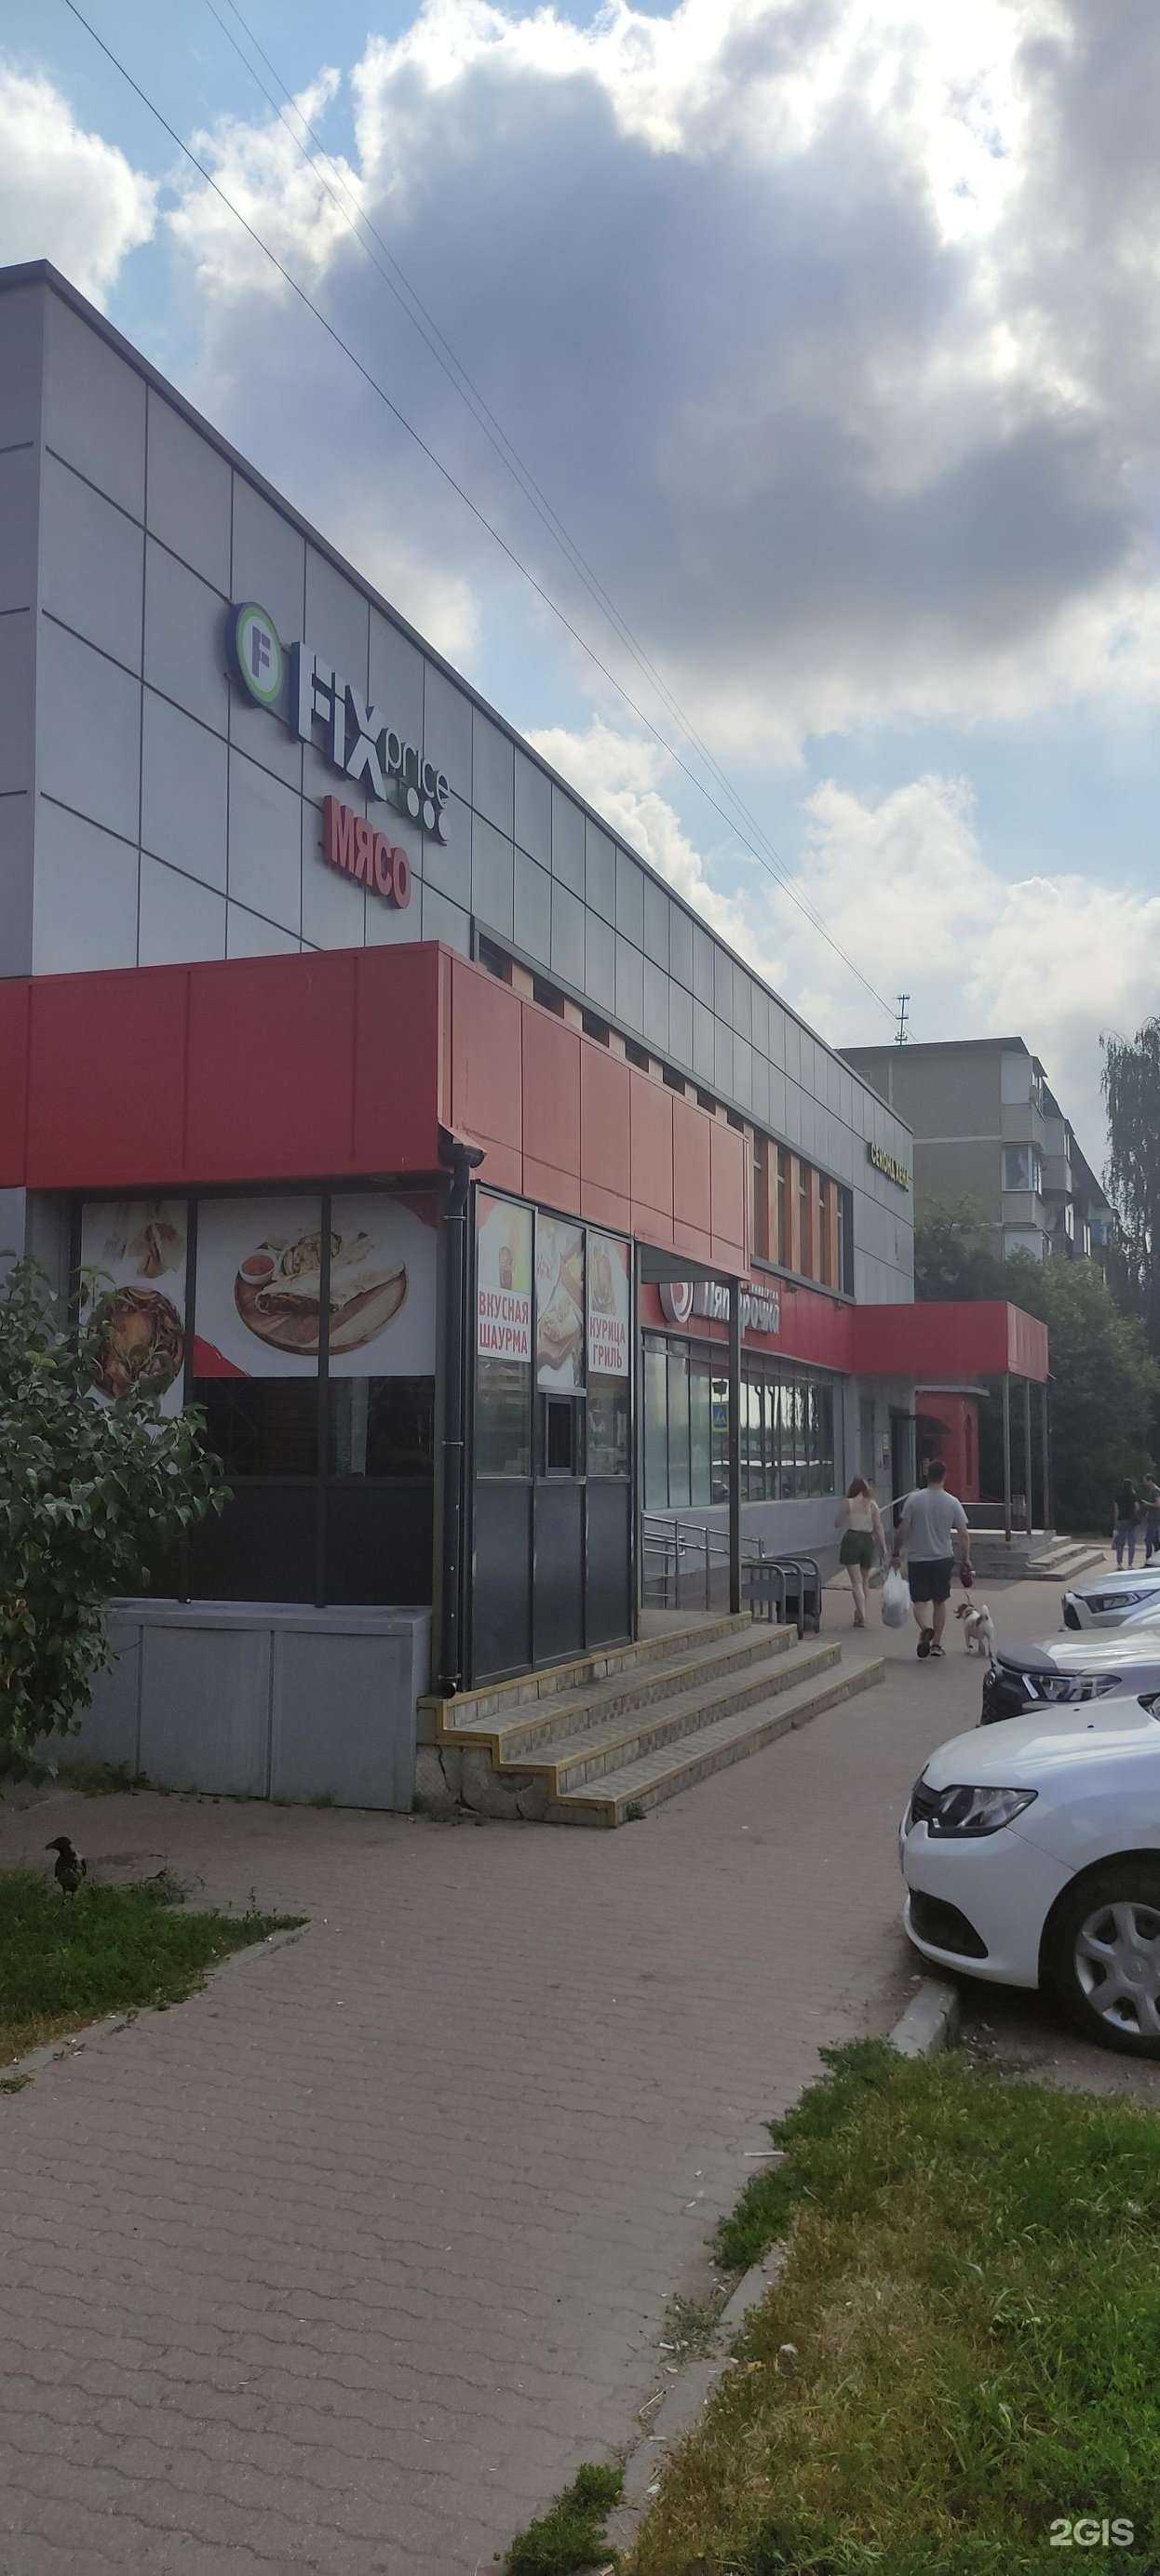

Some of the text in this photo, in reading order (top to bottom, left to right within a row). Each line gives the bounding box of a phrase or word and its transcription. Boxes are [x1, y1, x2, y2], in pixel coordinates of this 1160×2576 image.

[384, 727, 451, 809] price
[324, 795, 411, 909] МЯСО
[479, 1291, 529, 1325] ВКУСНАЯ
[479, 1322, 528, 1355] ШАУРМА
[589, 1316, 626, 1345] КУРИЦА
[593, 1344, 623, 1369] ГРИЛЬ
